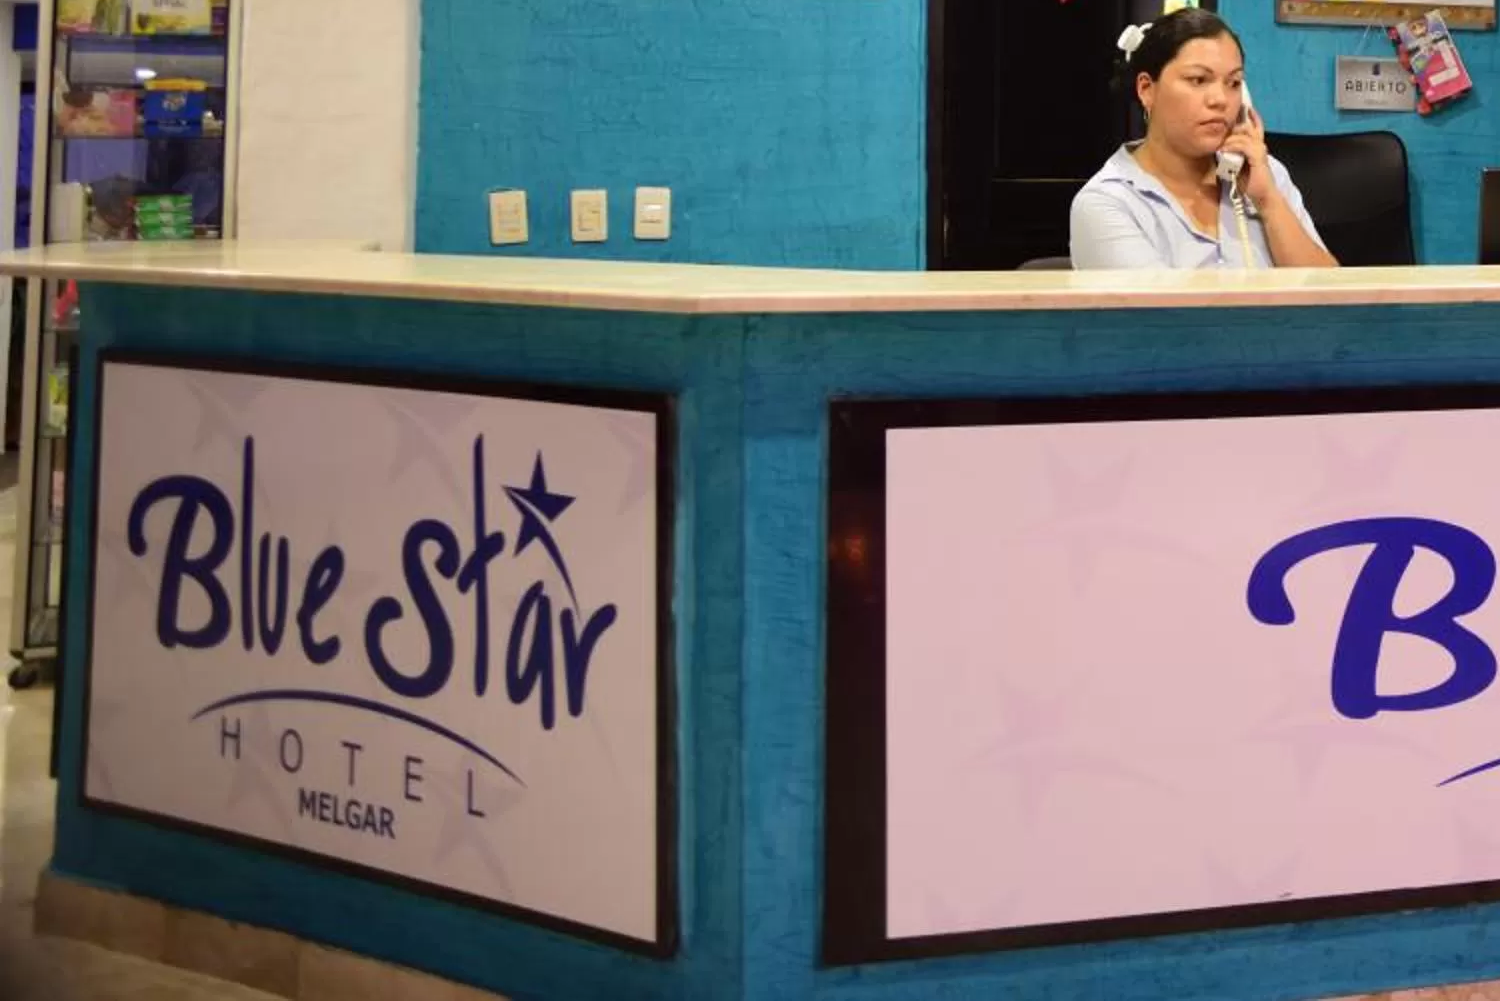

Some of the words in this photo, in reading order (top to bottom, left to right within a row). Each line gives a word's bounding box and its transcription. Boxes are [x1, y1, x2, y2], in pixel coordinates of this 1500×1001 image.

[1345, 79, 1407, 95] ABIERTO
[128, 435, 345, 665] Blue
[364, 432, 617, 731] Star
[220, 717, 486, 818] HOTEL
[299, 789, 396, 840] MELGAR
